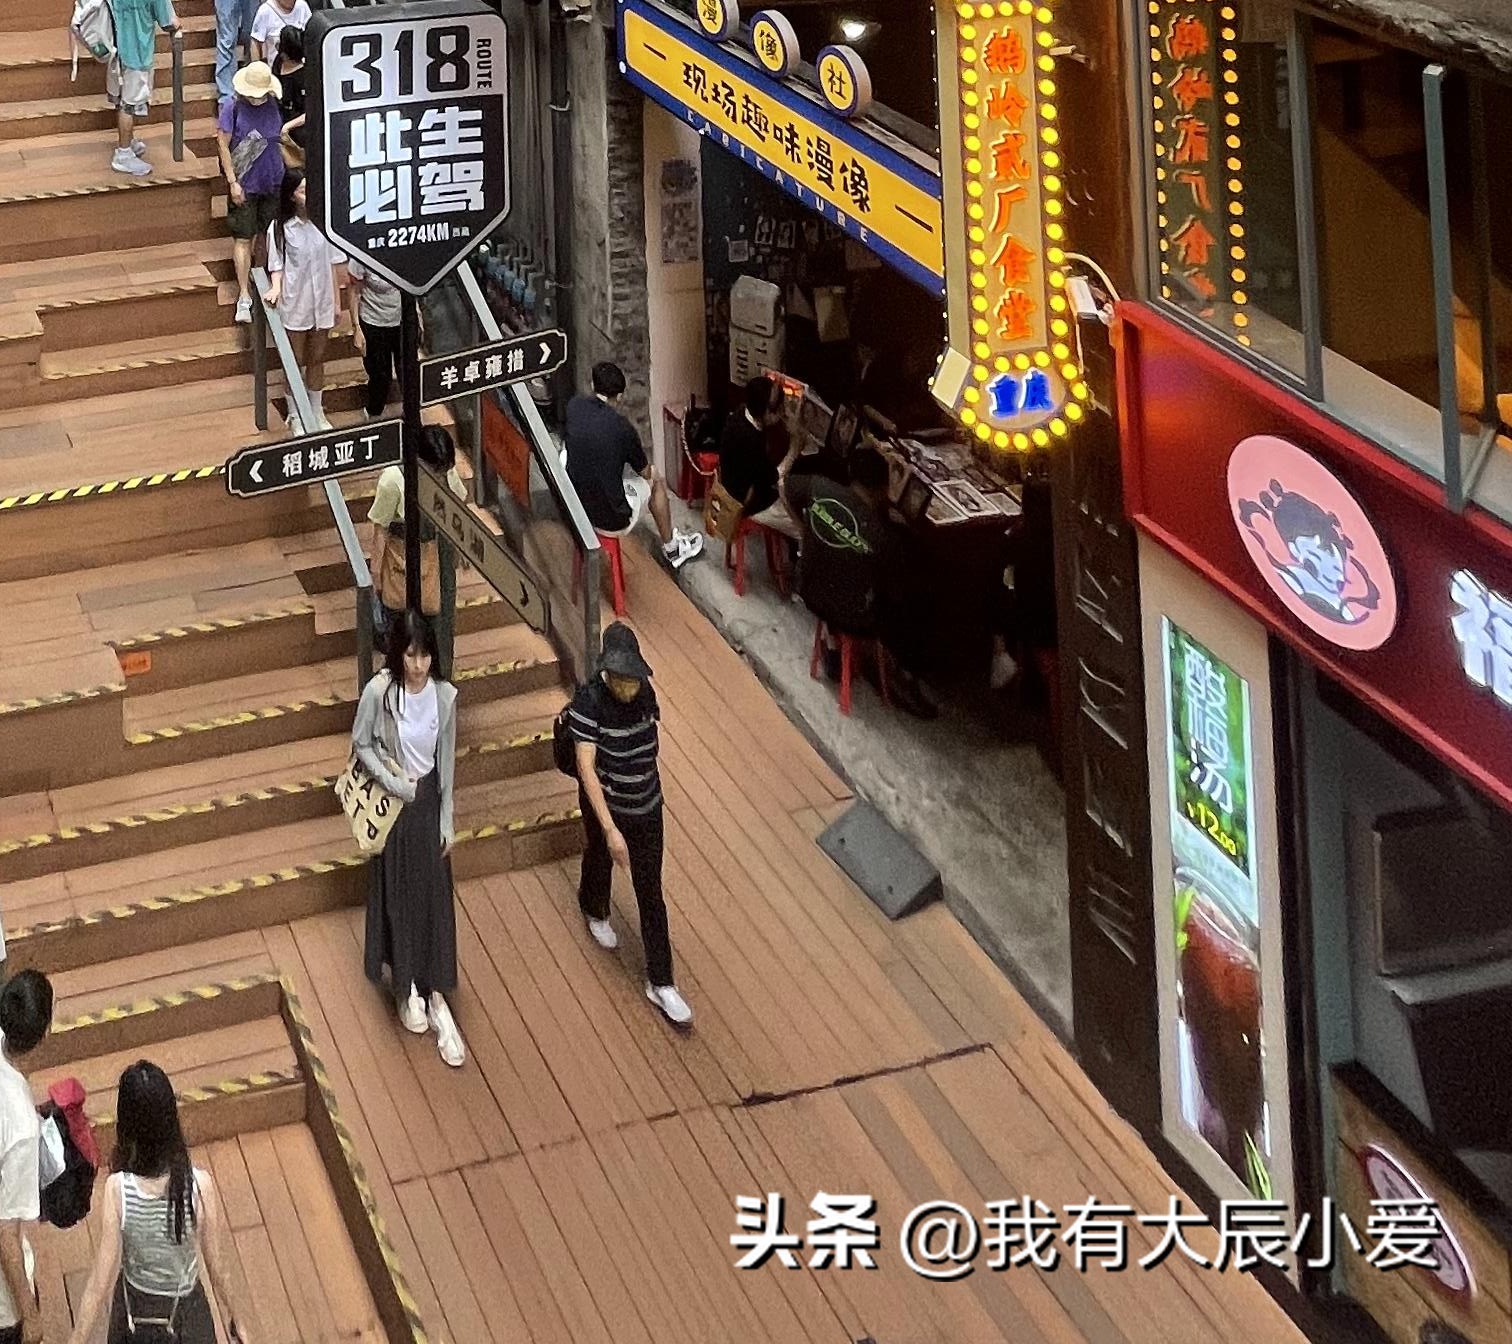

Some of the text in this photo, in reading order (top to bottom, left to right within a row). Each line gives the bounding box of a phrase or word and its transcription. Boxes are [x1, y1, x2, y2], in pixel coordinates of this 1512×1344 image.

[340, 24, 471, 102] 318
[476, 38, 492, 90] ROUTE
[349, 106, 484, 169] 此生
[682, 61, 871, 214] 现场趣味漫像
[349, 160, 485, 224] 必驾
[983, 25, 1037, 340] 鹅岭贰厂食堂
[388, 222, 449, 248] 2274KM
[440, 348, 525, 391] 羊卓雍措
[282, 434, 380, 478] 稻城亚丁
